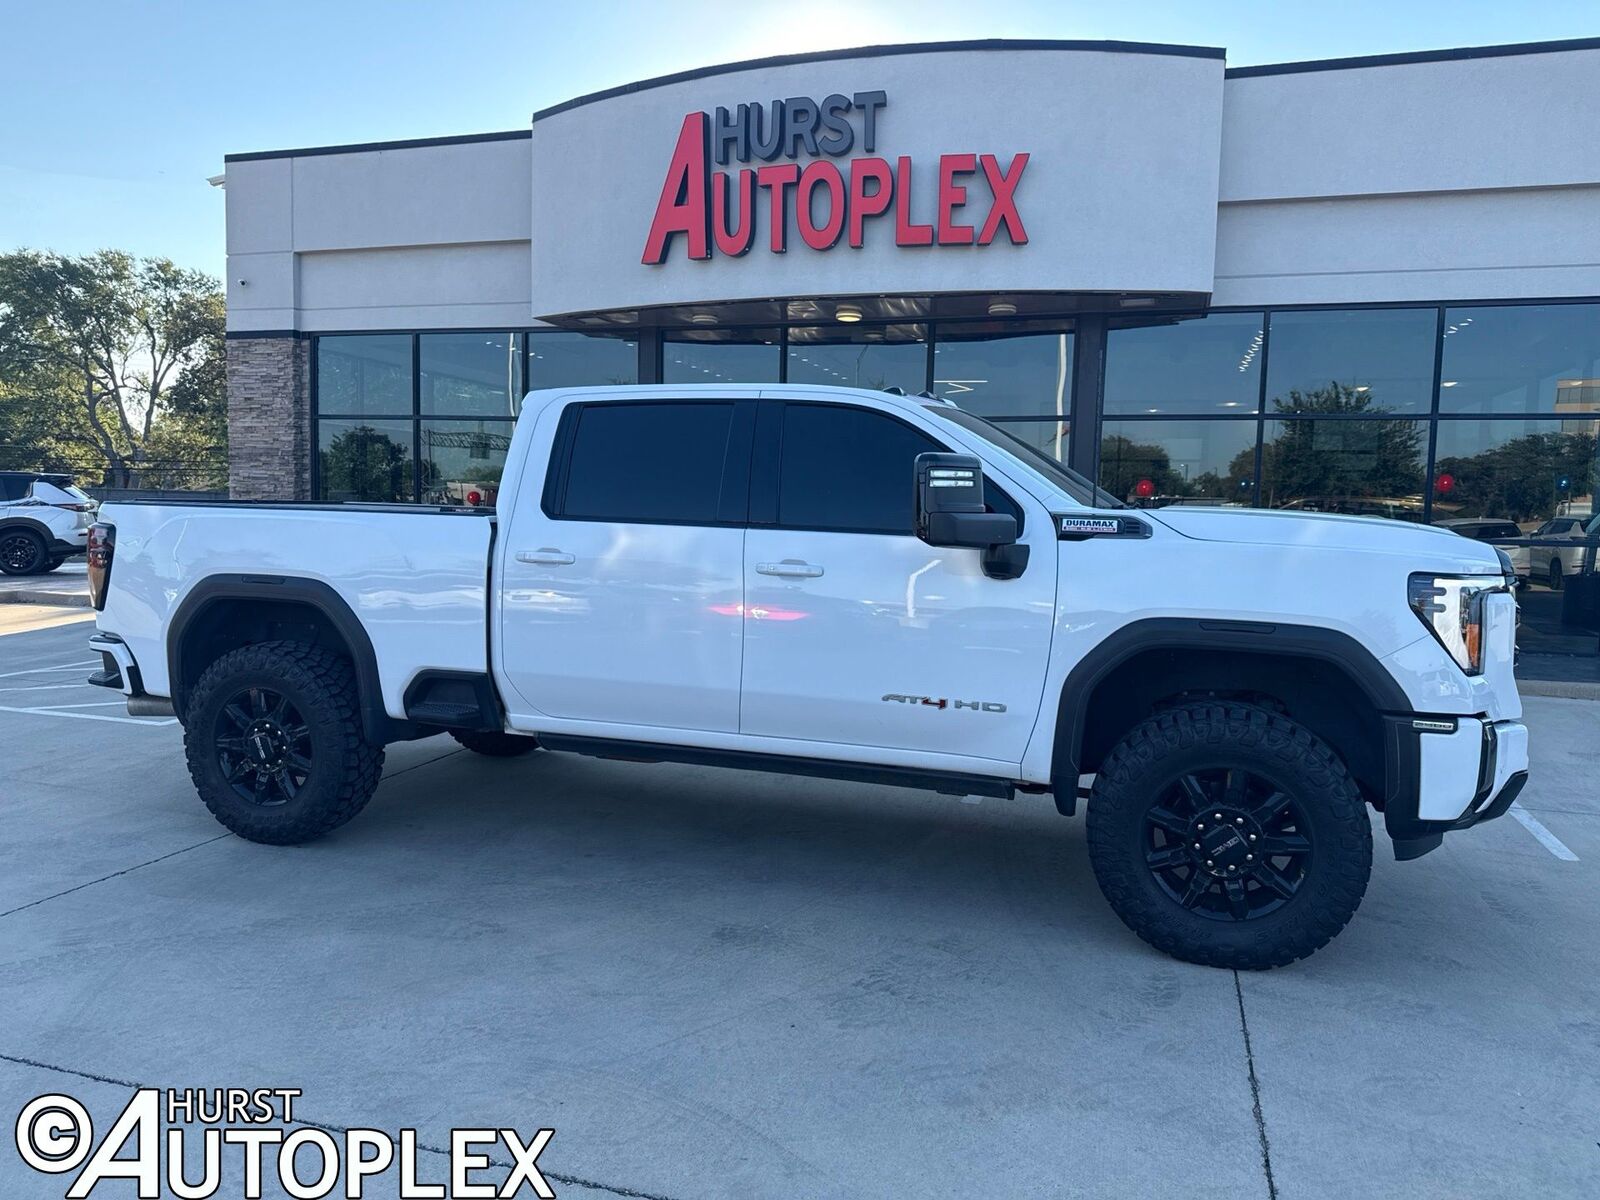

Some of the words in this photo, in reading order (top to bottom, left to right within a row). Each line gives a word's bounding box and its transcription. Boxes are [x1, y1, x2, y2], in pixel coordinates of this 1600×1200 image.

[715, 90, 887, 165] HURST
[641, 111, 1030, 265] AUTOPLEX
[882, 694, 948, 710] AT4
[954, 700, 1007, 713] HD
